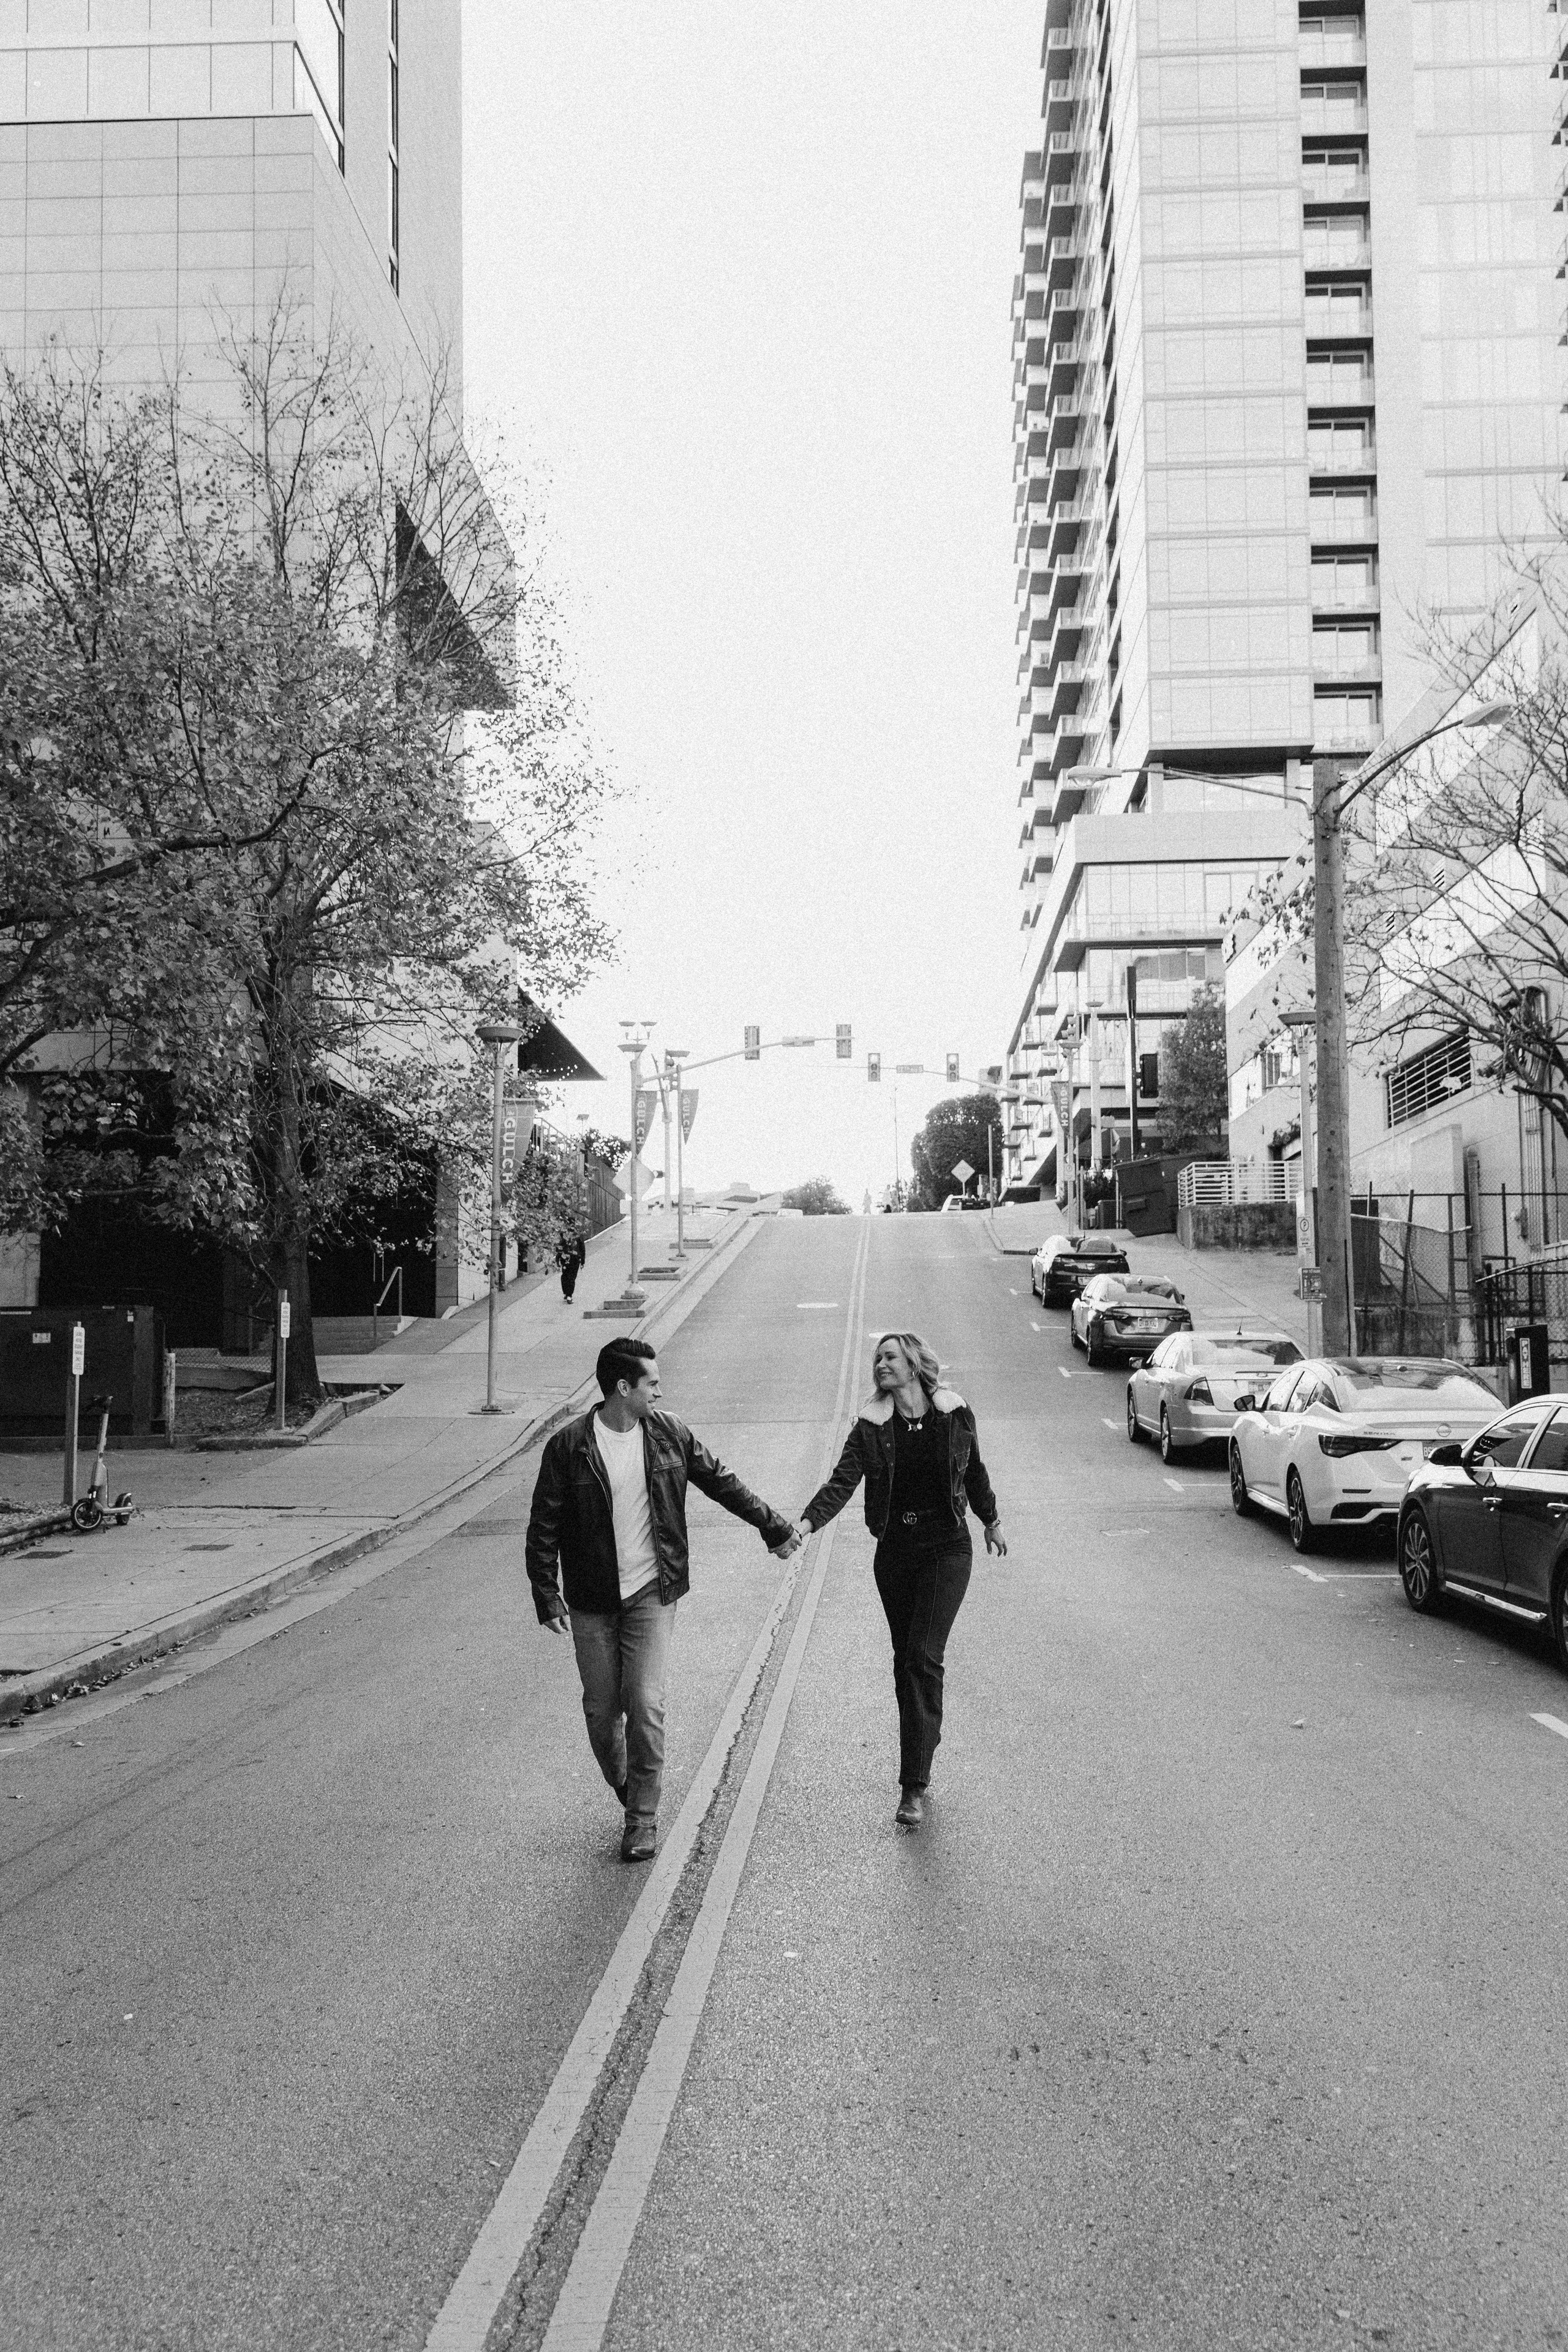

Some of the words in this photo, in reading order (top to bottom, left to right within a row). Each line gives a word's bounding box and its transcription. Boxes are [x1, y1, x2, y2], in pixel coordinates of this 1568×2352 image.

[636, 1100, 646, 1145] GULCH
[1060, 1089, 1069, 1127] GULCH
[502, 1117, 516, 1183] GULCH
